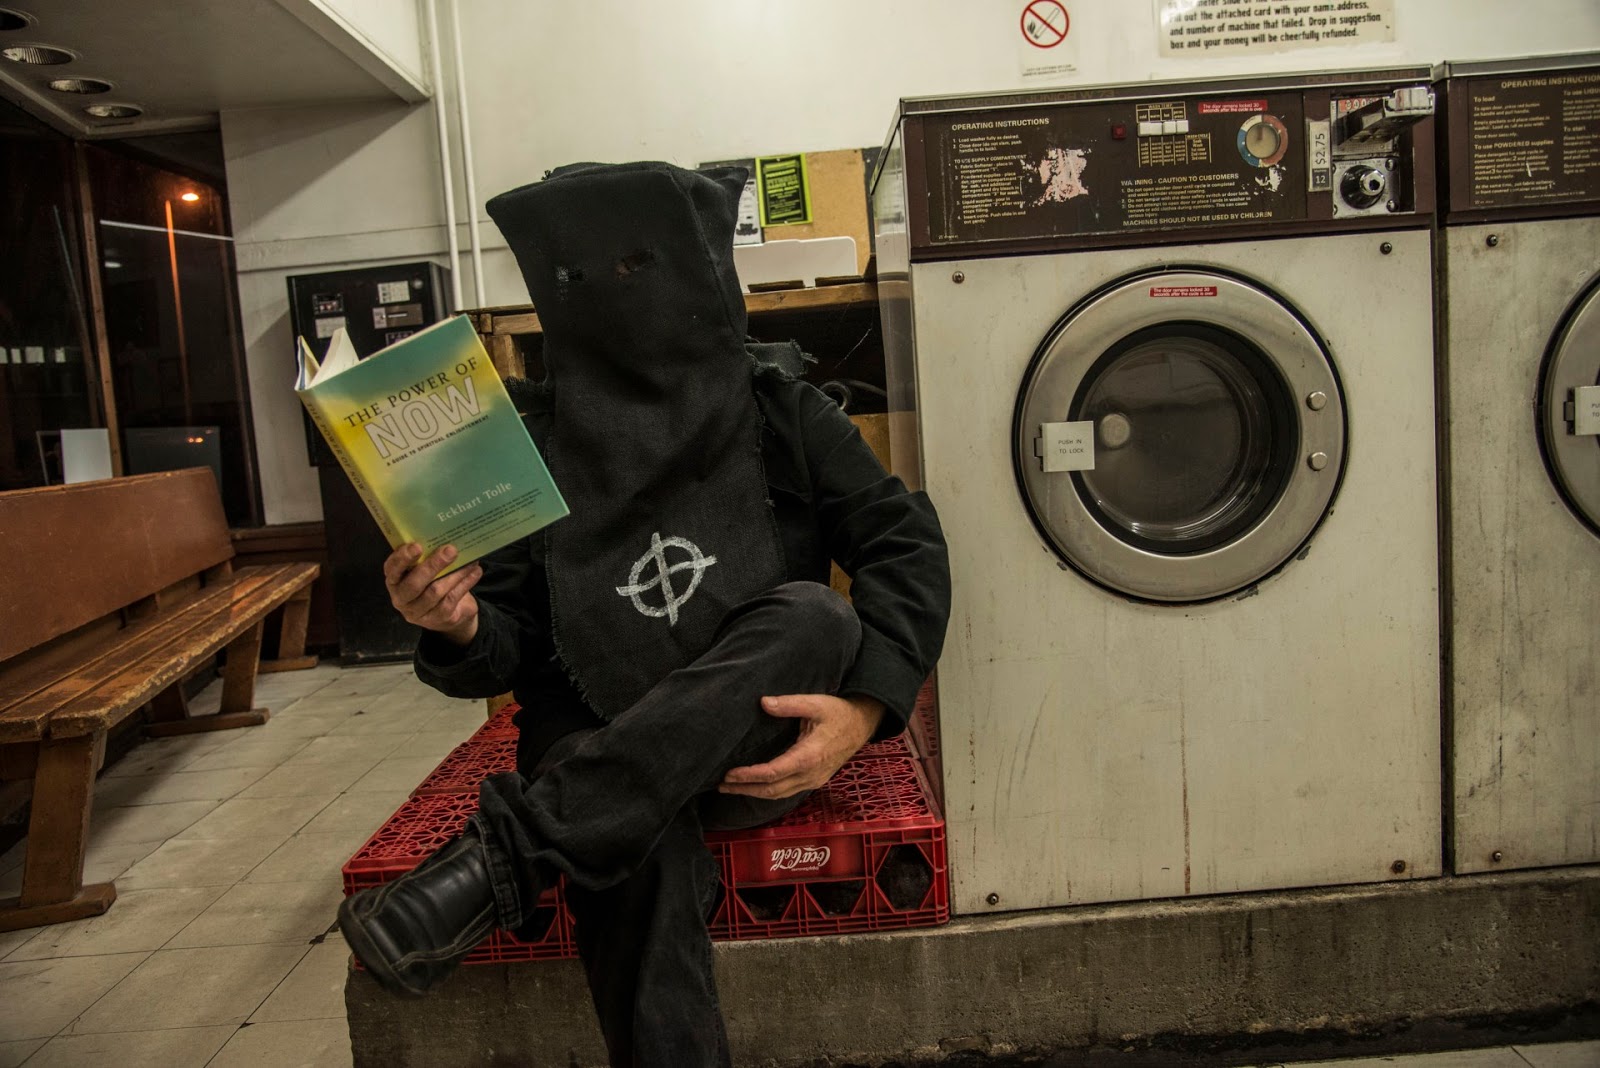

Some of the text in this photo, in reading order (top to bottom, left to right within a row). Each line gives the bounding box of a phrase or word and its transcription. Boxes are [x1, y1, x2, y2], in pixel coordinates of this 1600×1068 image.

[1170, 13, 1381, 36] and number of machine that failed. Drop in suggestion
[1184, 12, 1197, 21] out
[1200, 10, 1212, 20] the
[1216, 8, 1251, 18] attached
[1254, 6, 1271, 16] card
[1274, 5, 1290, 14] with
[1293, 6, 1310, 16] your
[1170, 28, 1359, 50] box and your money will be cheerfully refunded.
[1501, 79, 1546, 88] OPERATING
[952, 118, 1050, 131] OPERATING INSTRUCTIONS
[1315, 133, 1326, 165] $2.75
[1199, 173, 1239, 181] CUSTOMERS
[1315, 175, 1325, 184] 12
[344, 357, 478, 428] THE POWER OF
[364, 375, 481, 460] NOW
[306, 403, 321, 421] THE
[320, 424, 344, 456] POWER
[342, 457, 351, 468] OF
[350, 471, 367, 492] NOW
[392, 453, 408, 464] GUIDE
[417, 437, 444, 451] SPIRITUAL
[446, 415, 489, 439] ENLIGHTENMENT
[437, 482, 512, 522] Eckhart Tolle
[770, 846, 830, 872] Coca-Cola
